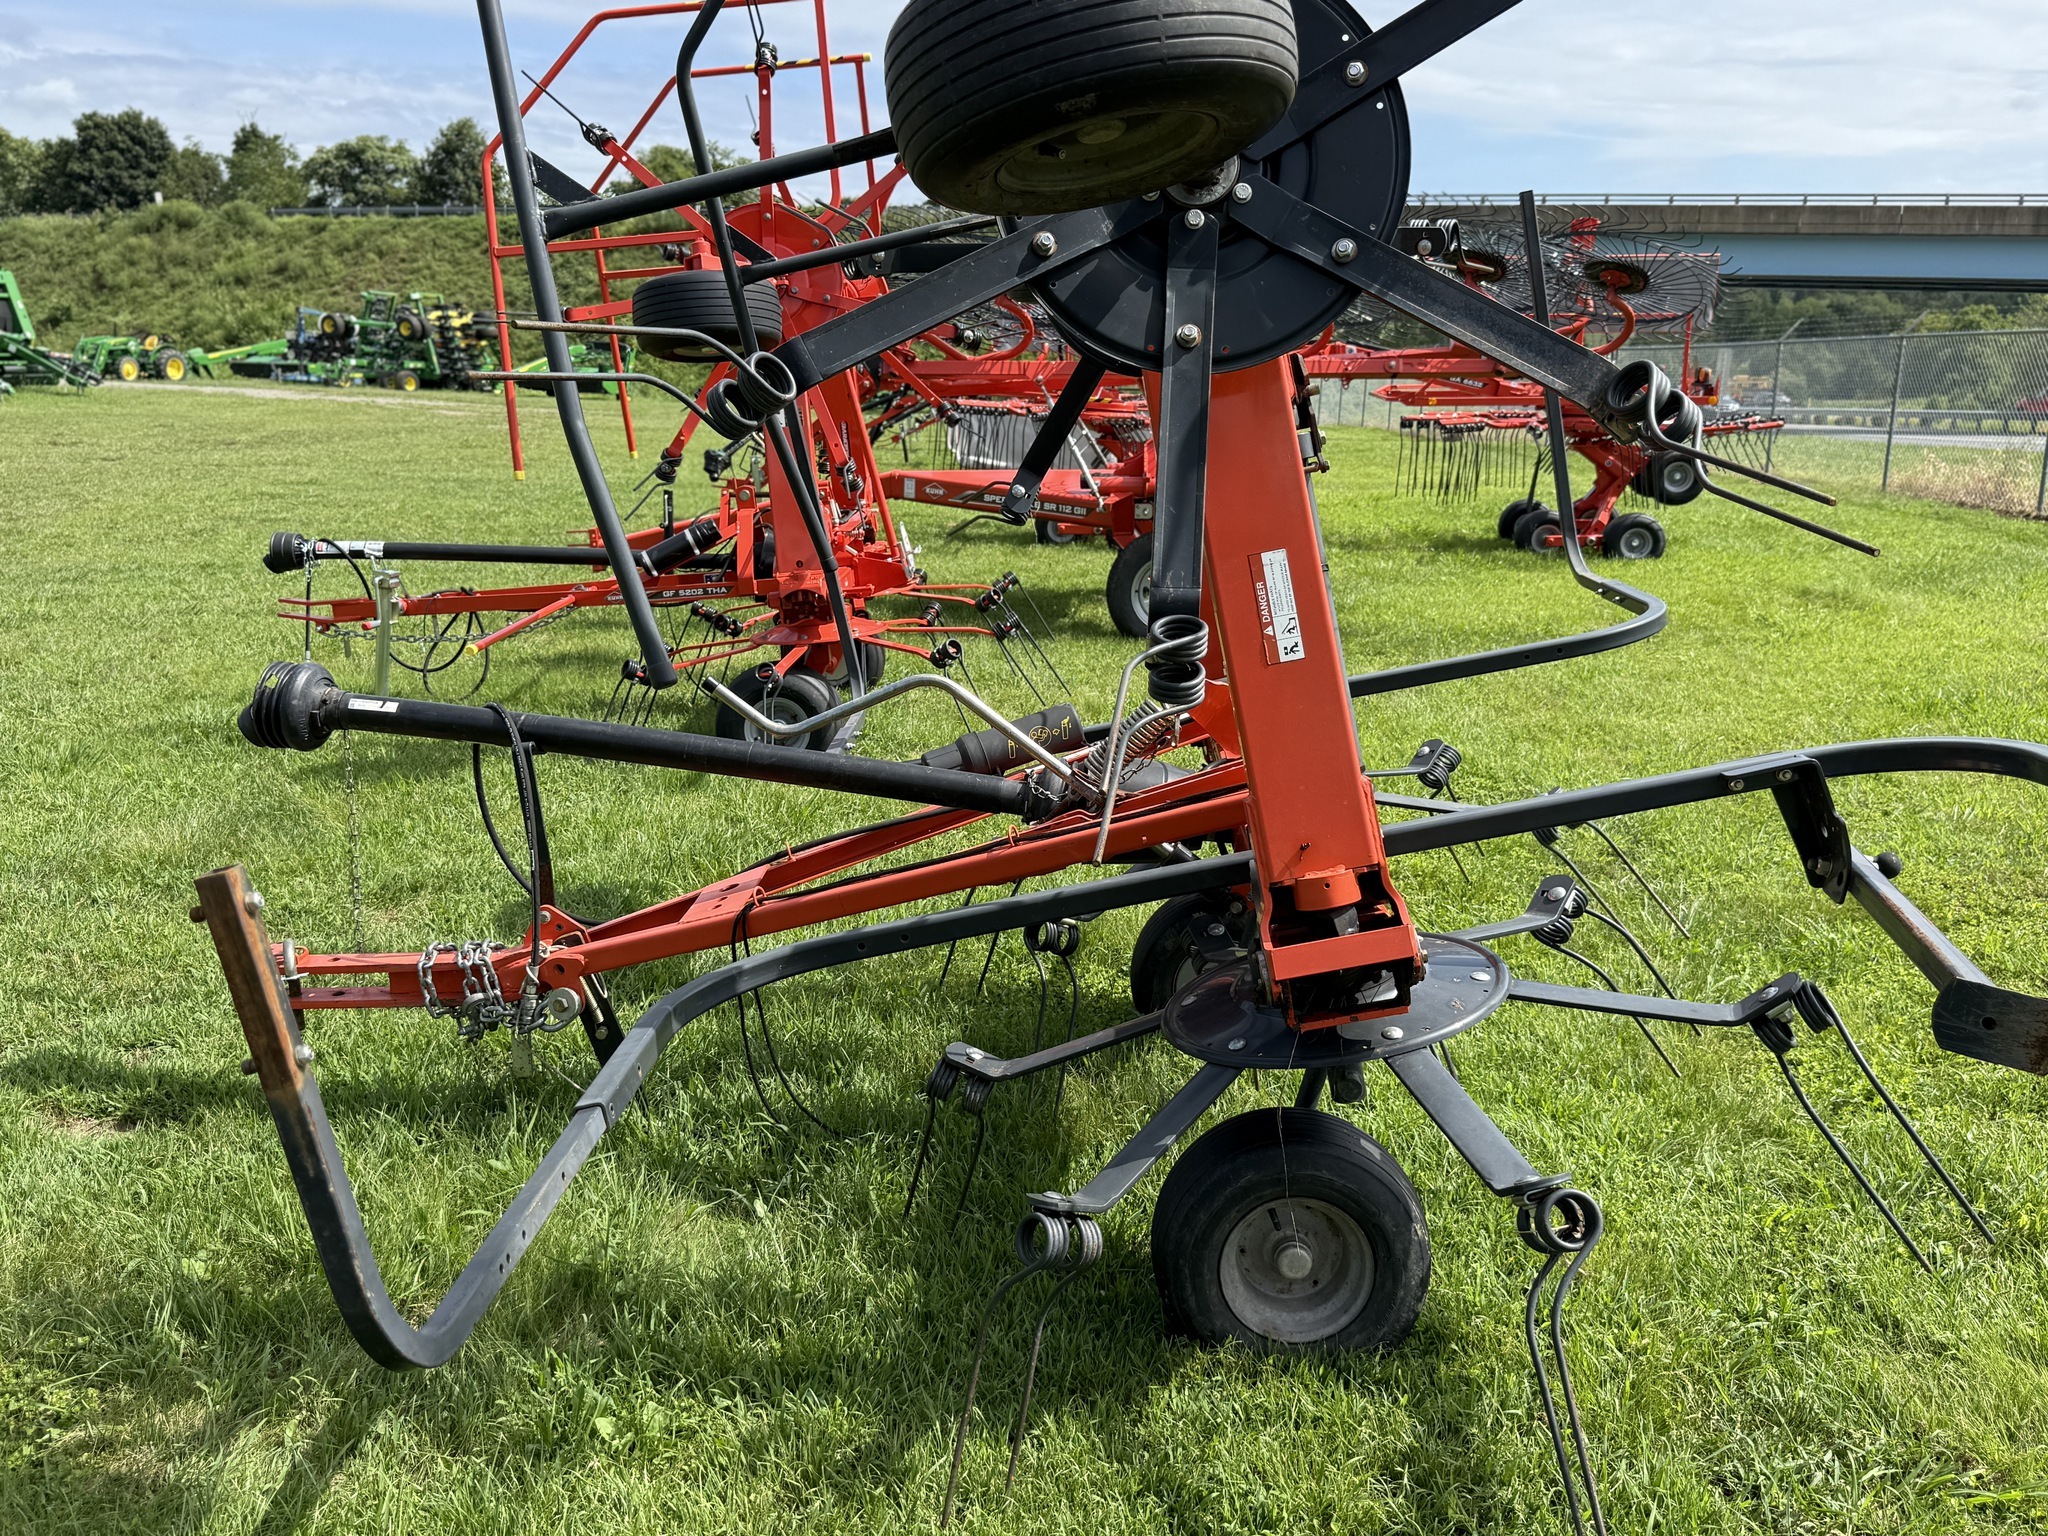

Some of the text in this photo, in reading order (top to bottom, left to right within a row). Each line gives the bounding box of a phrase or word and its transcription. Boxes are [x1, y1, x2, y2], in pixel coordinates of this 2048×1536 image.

[925, 487, 944, 496] KUHN
[1043, 502, 1056, 511] SR
[1058, 504, 1072, 512] 112
[1073, 507, 1087, 515] GII
[662, 590, 676, 598] GF
[706, 586, 728, 594] THA
[1256, 581, 1270, 623] DANGER
